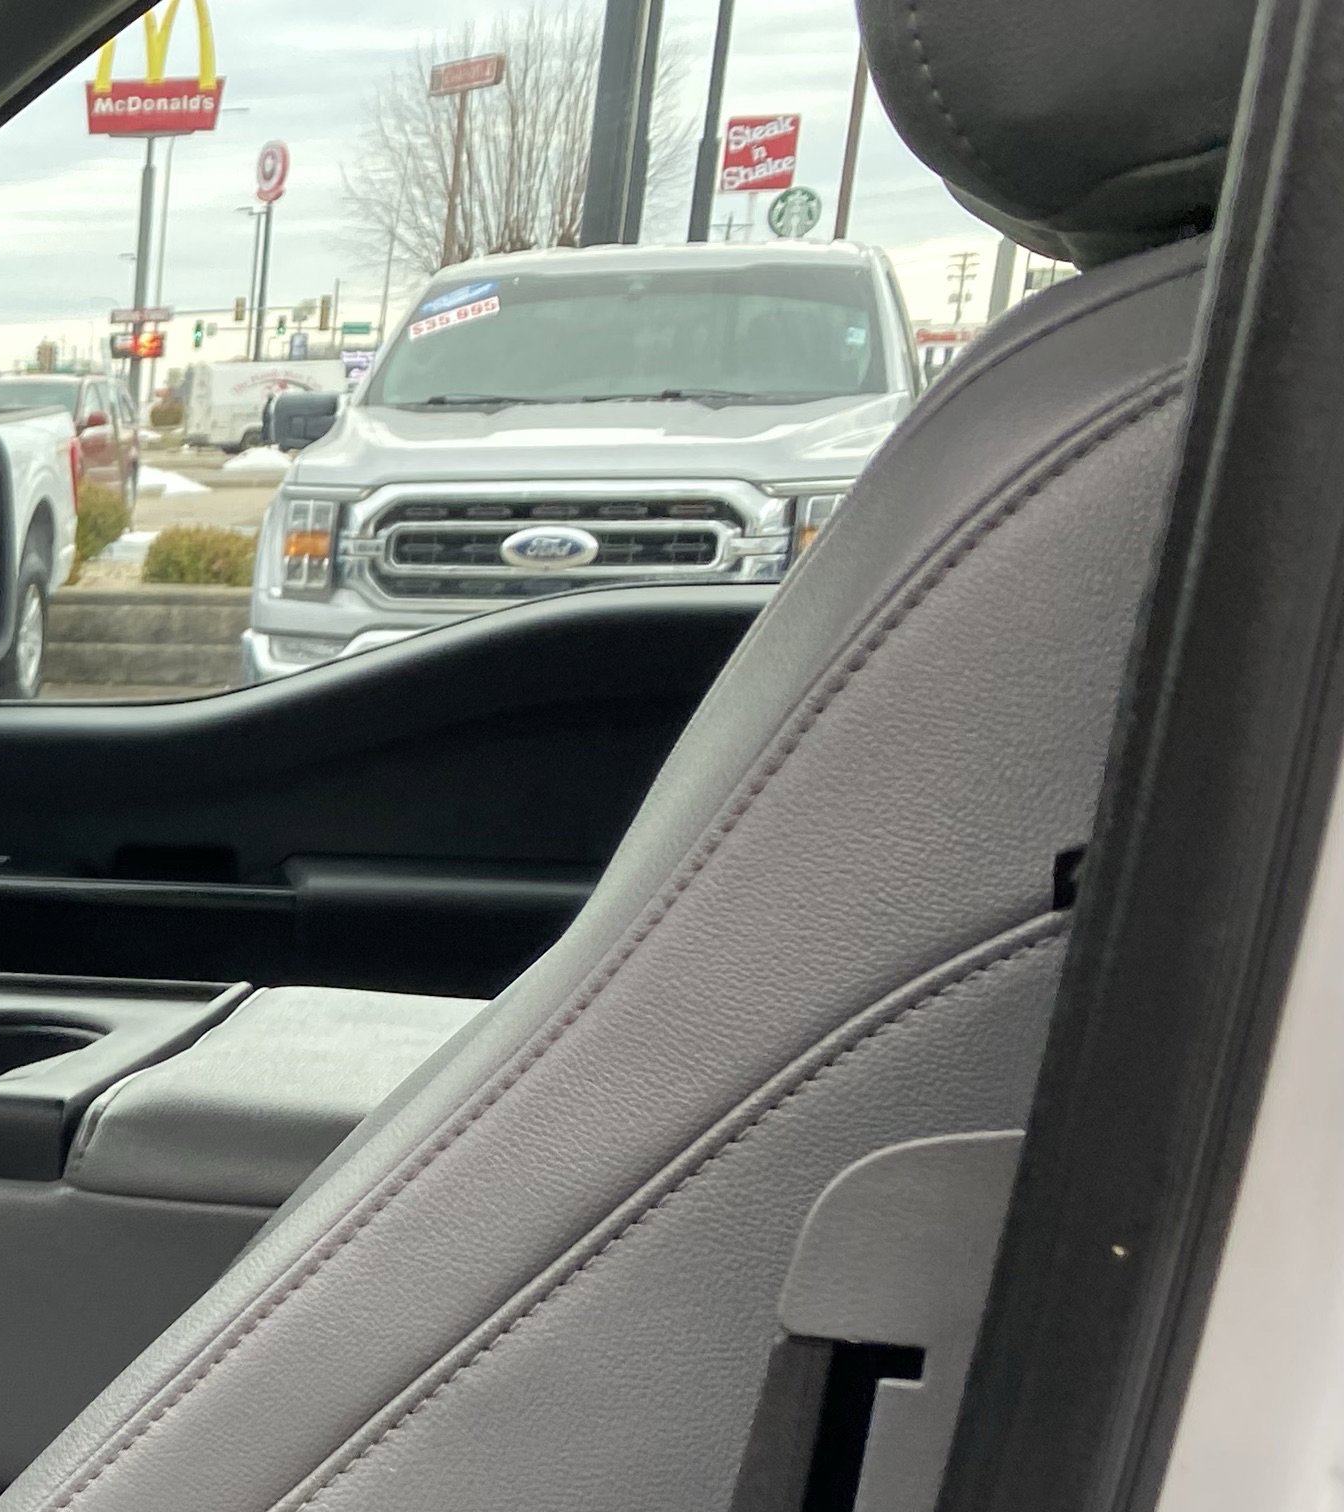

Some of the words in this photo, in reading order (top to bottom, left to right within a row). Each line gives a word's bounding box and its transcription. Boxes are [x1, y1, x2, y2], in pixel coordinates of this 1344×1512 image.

[93, 94, 216, 114] McDonald's
[727, 117, 797, 153] Steak
[722, 155, 796, 190] Shake
